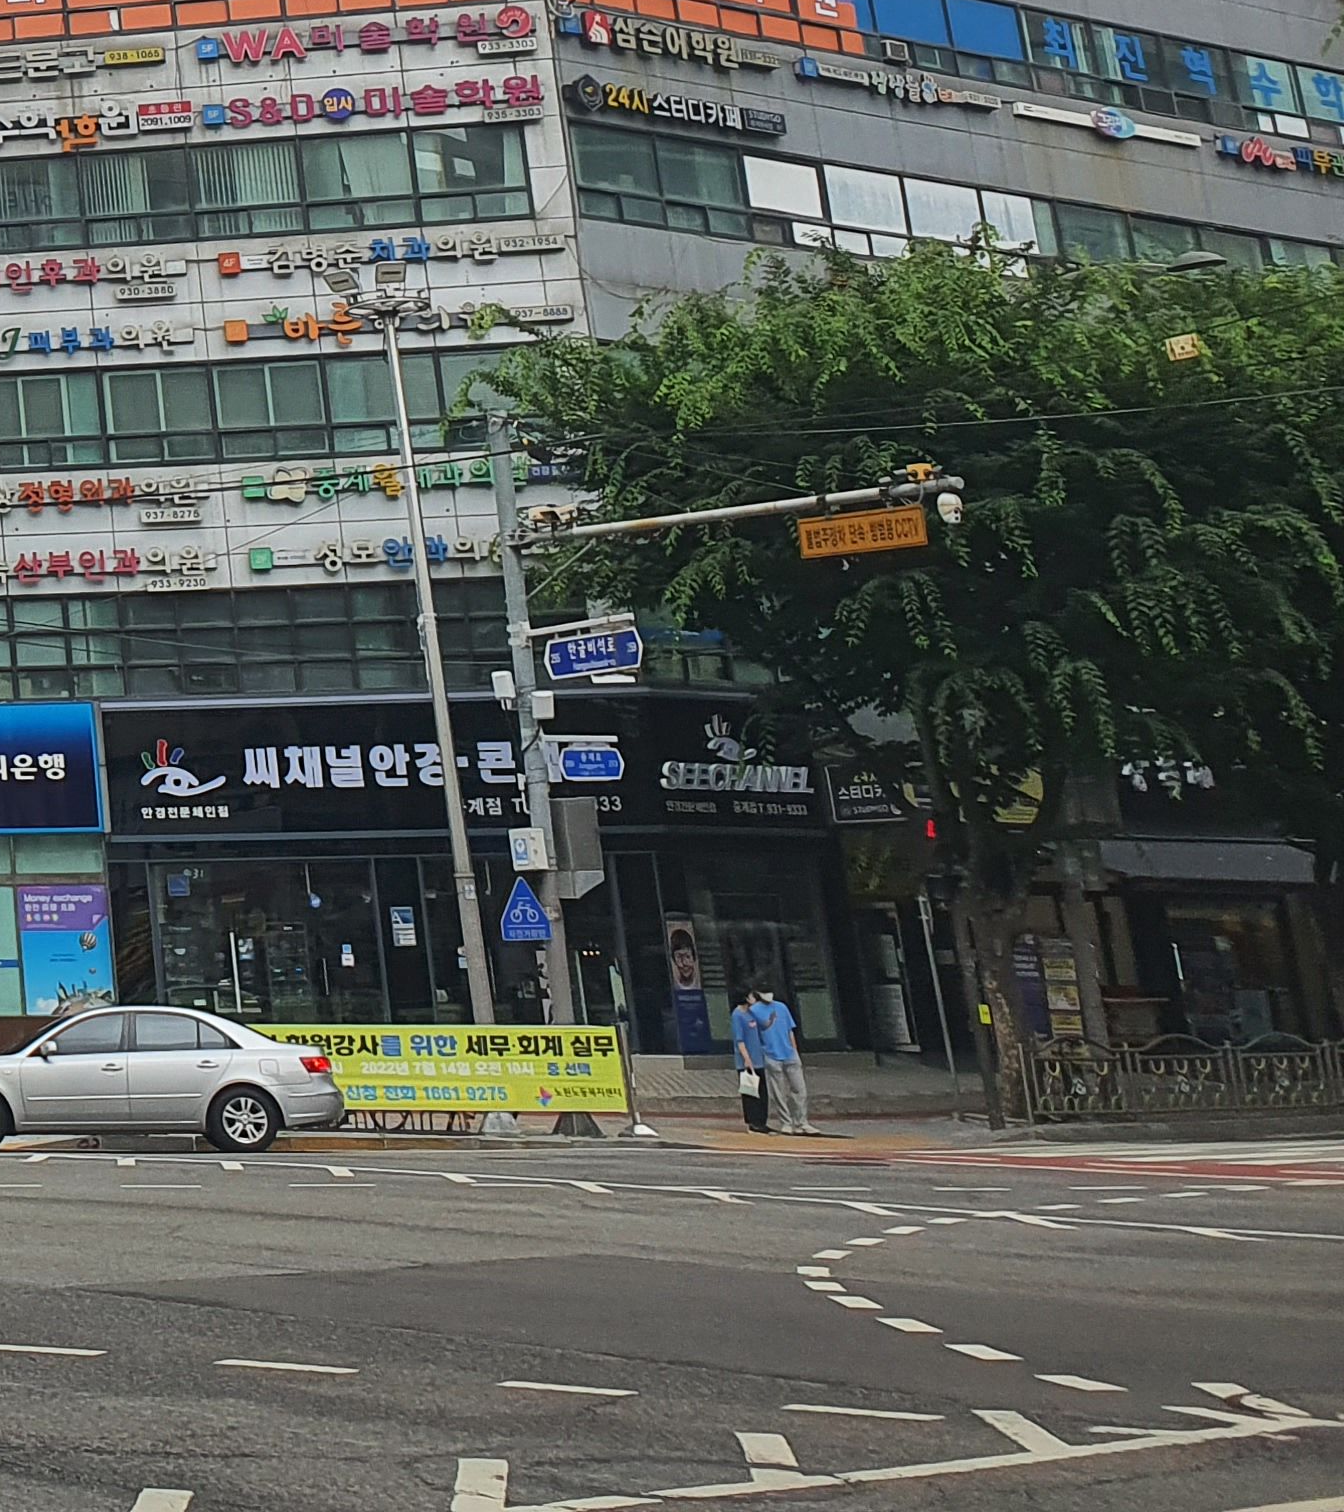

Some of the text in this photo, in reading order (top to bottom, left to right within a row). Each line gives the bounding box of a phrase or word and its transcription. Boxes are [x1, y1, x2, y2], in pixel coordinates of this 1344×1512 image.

[223, 25, 308, 63] WA
[612, 15, 740, 70] 심슨어학원
[364, 74, 545, 120] 미술학원
[604, 81, 650, 116] 24시
[652, 92, 743, 132] 스터디카페
[660, 760, 815, 794] SEECHANNEL
[23, 892, 93, 904] Money exchange
[410, 1034, 458, 1057] 위한
[570, 1034, 615, 1057] 실무
[423, 1085, 461, 1101] 1661
[466, 1085, 509, 1102] 9275
